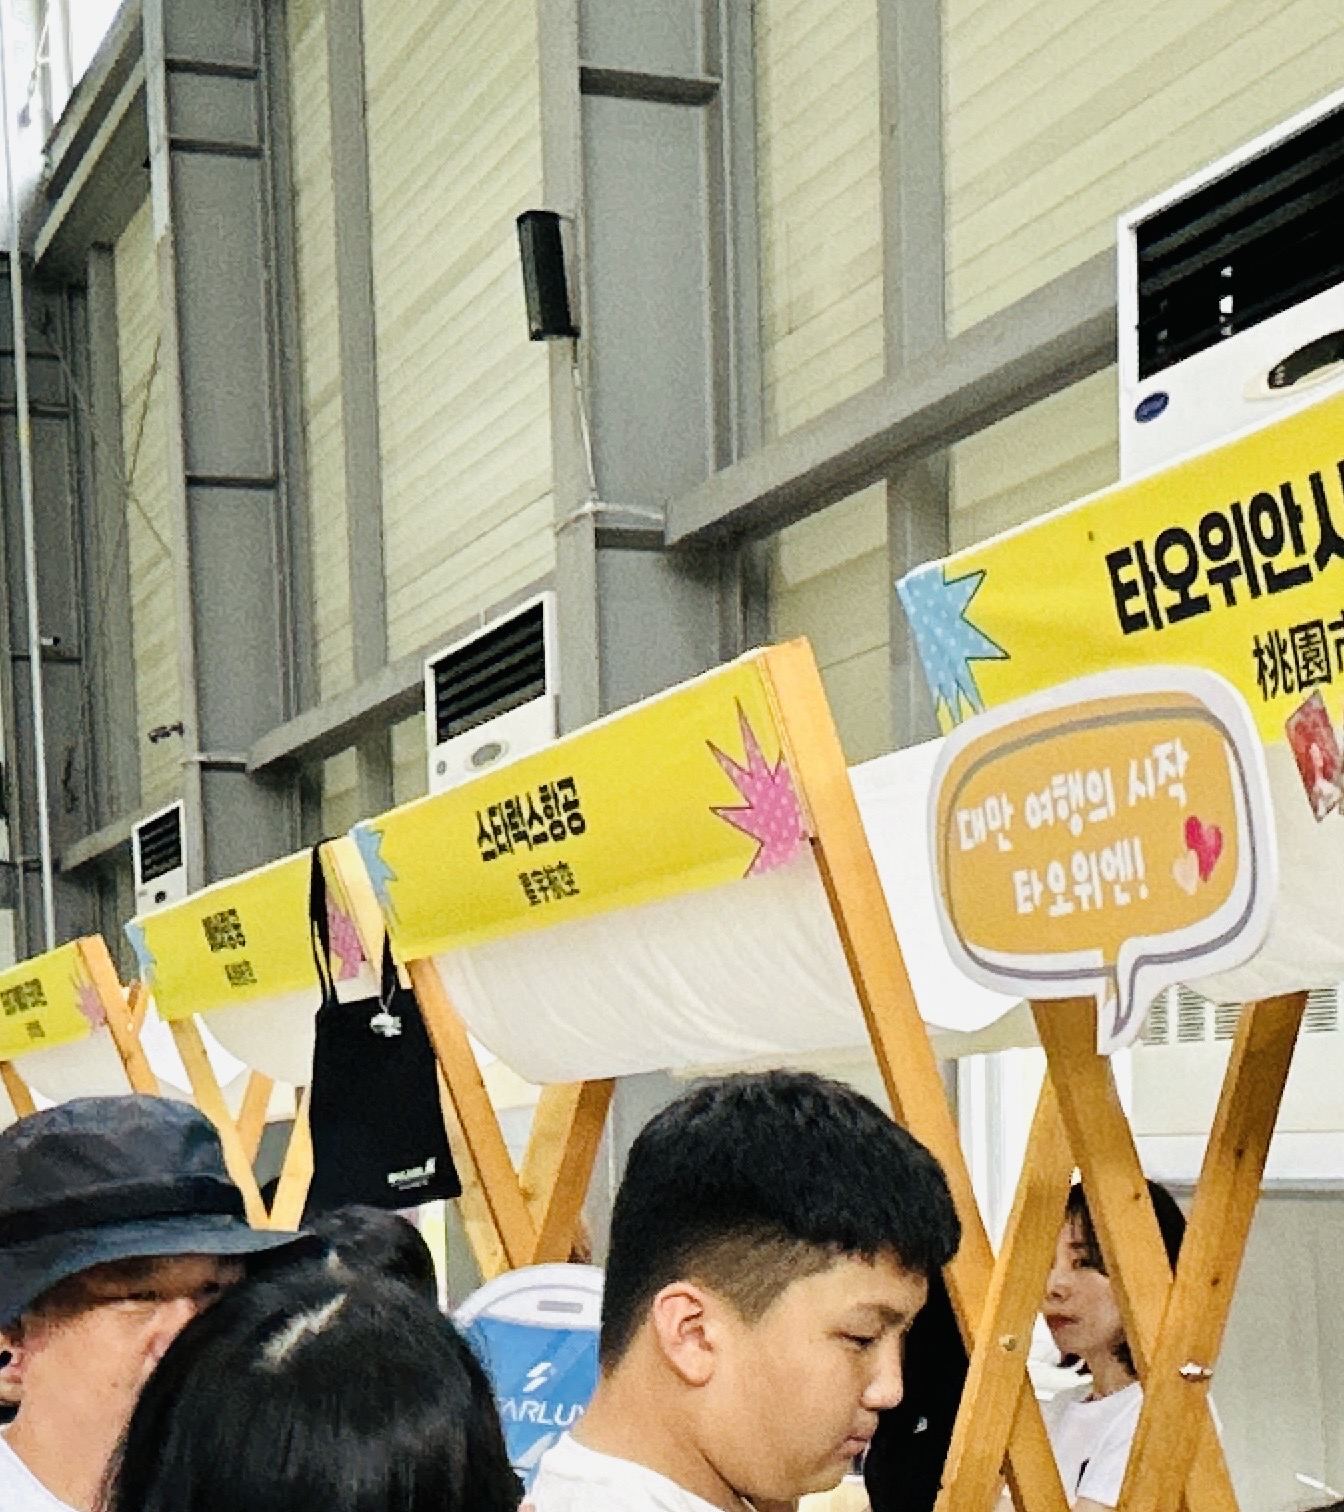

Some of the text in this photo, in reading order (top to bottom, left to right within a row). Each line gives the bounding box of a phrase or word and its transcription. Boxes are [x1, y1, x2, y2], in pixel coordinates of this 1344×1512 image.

[476, 776, 586, 861] 스타럭스항공
[957, 737, 1190, 852] 대만 여행의 시작
[1012, 836, 1150, 918] 타오위엔!
